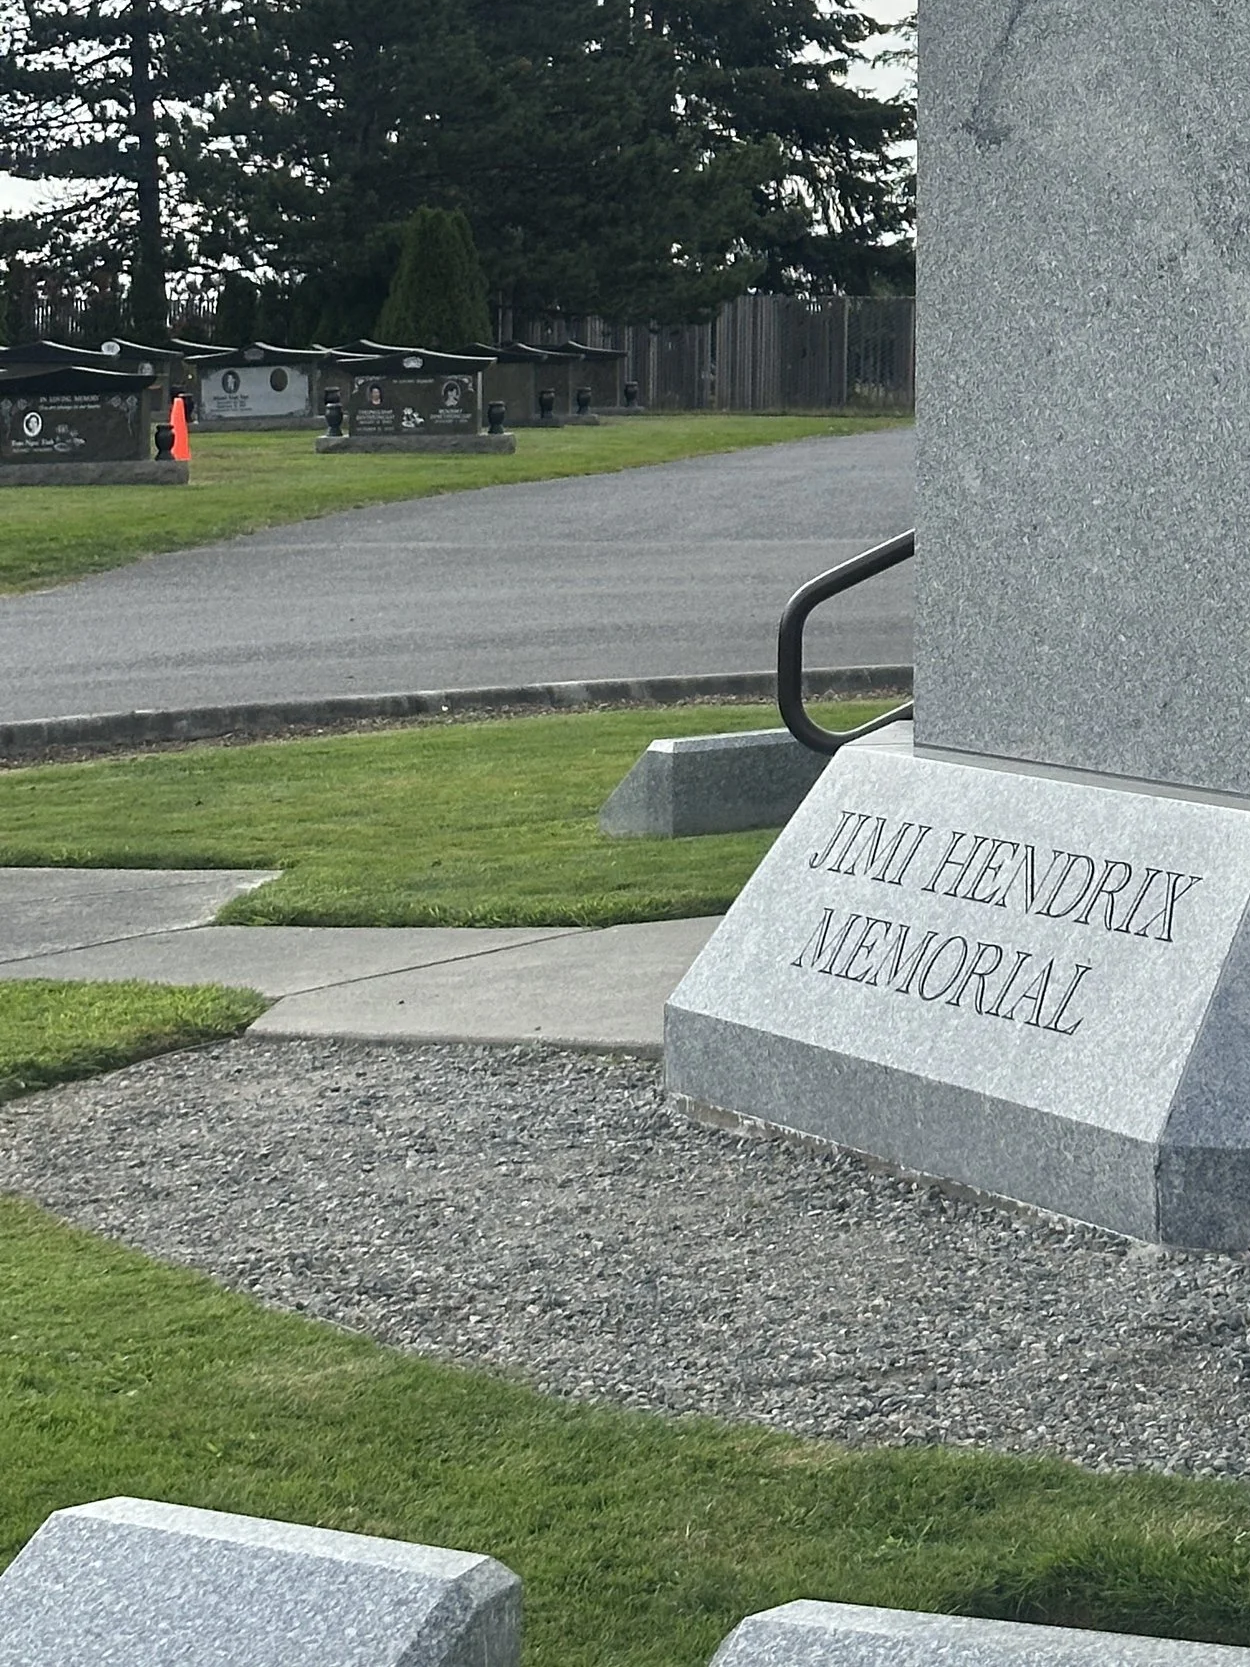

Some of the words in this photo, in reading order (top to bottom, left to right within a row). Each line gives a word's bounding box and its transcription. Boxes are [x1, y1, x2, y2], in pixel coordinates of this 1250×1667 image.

[808, 810, 932, 886] JIMI
[921, 831, 1204, 943] HENDRIX
[790, 907, 1093, 1036] MEMORIAL
